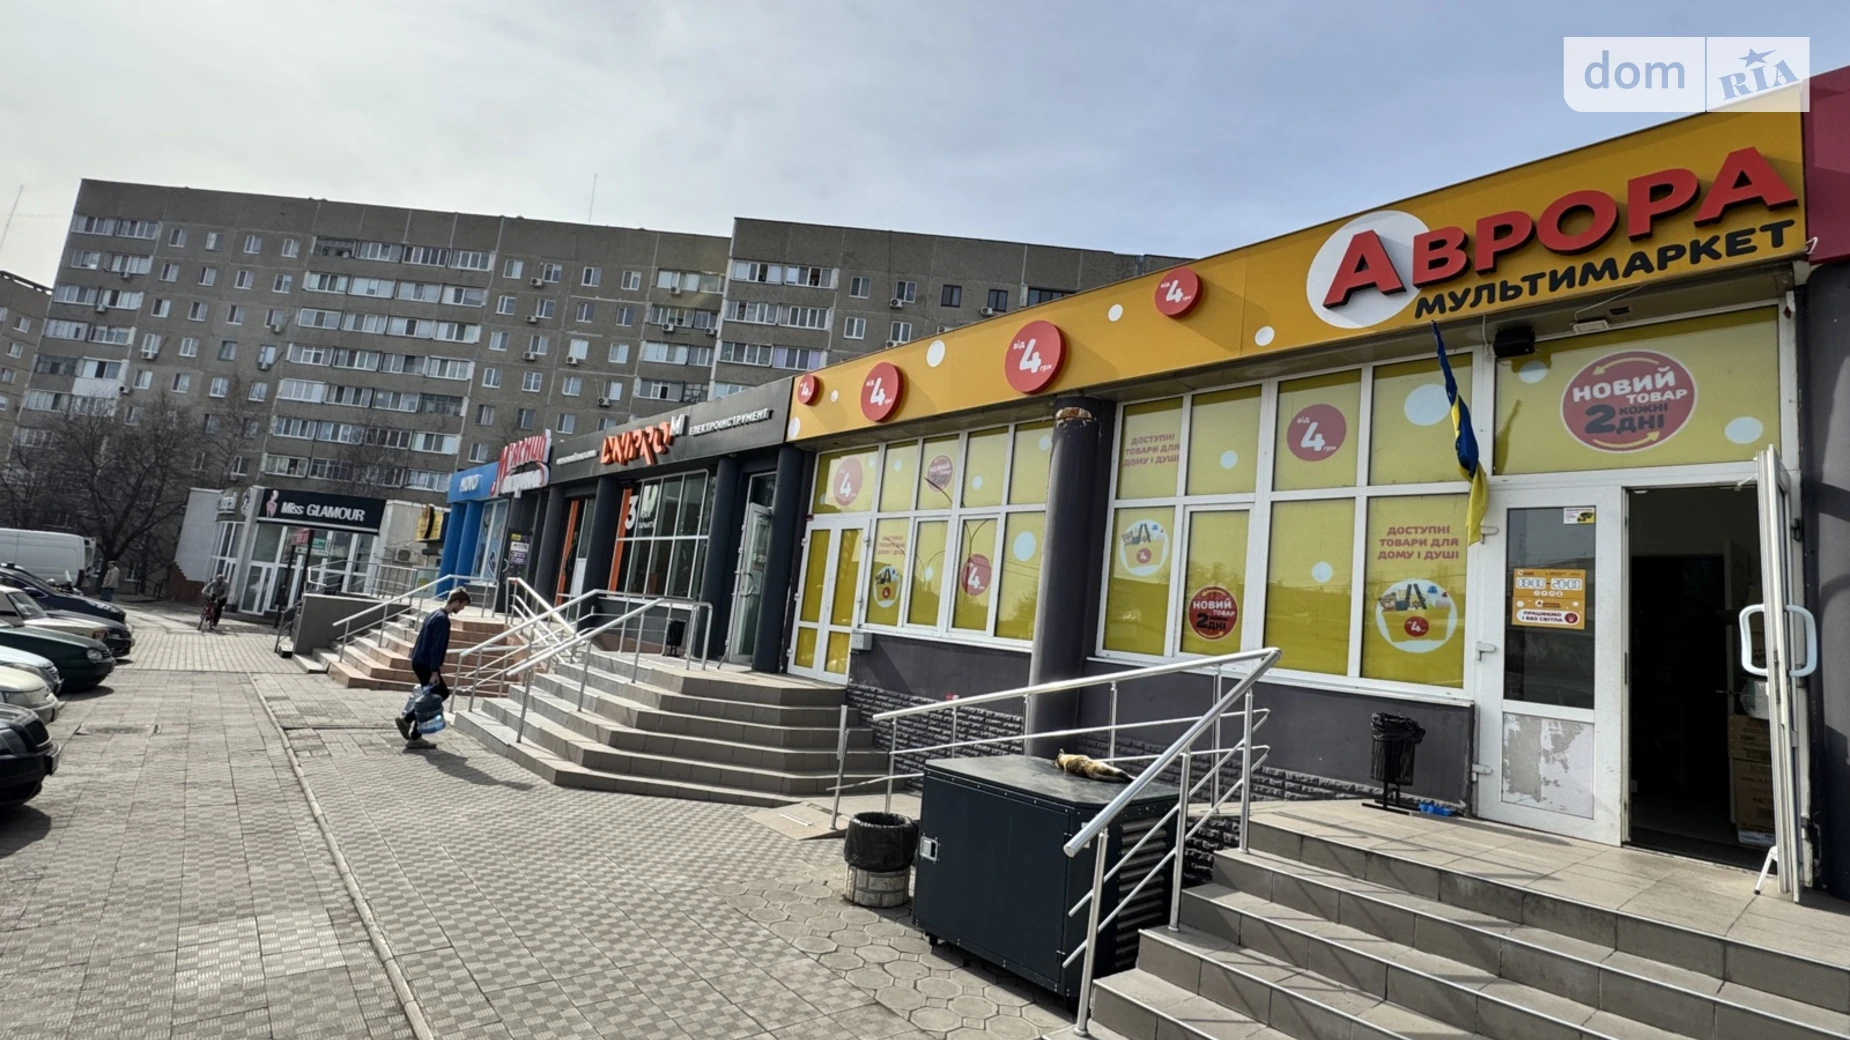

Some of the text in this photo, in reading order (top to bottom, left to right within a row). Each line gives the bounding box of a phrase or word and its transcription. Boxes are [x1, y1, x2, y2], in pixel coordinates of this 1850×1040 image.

[1323, 145, 1799, 309] АВРОРА
[1414, 219, 1796, 319] МУЛЬТИМАРКЕТ
[1166, 279, 1184, 303] 4
[1019, 338, 1042, 373] 4
[870, 377, 886, 405] 4
[1572, 366, 1676, 402] НОВИЙ
[1625, 389, 1688, 404] ТОВАР
[1584, 404, 1665, 435] 2 ДНІ
[1619, 403, 1668, 415] КОЖНІ
[1130, 433, 1176, 446] ДОСТУПНІ
[1301, 421, 1326, 452] 4
[1124, 443, 1180, 456] ТОВАРИ ДЛЯ
[1123, 457, 1149, 468] ДОМУ
[839, 472, 852, 498] 4
[281, 501, 366, 522] Miss GLAMOUR
[624, 495, 639, 530] 3
[1387, 525, 1450, 536] ДОСТУПНІ
[1379, 538, 1459, 549] ТОВАРИ ДЛЯ
[1377, 551, 1414, 560] ДОМУ
[1423, 551, 1459, 560] ДУШІ
[967, 567, 981, 589] 4
[1192, 598, 1232, 610] НОВИЙ
[1196, 612, 1226, 631] 2 ДНІ
[1410, 621, 1421, 632] 4
